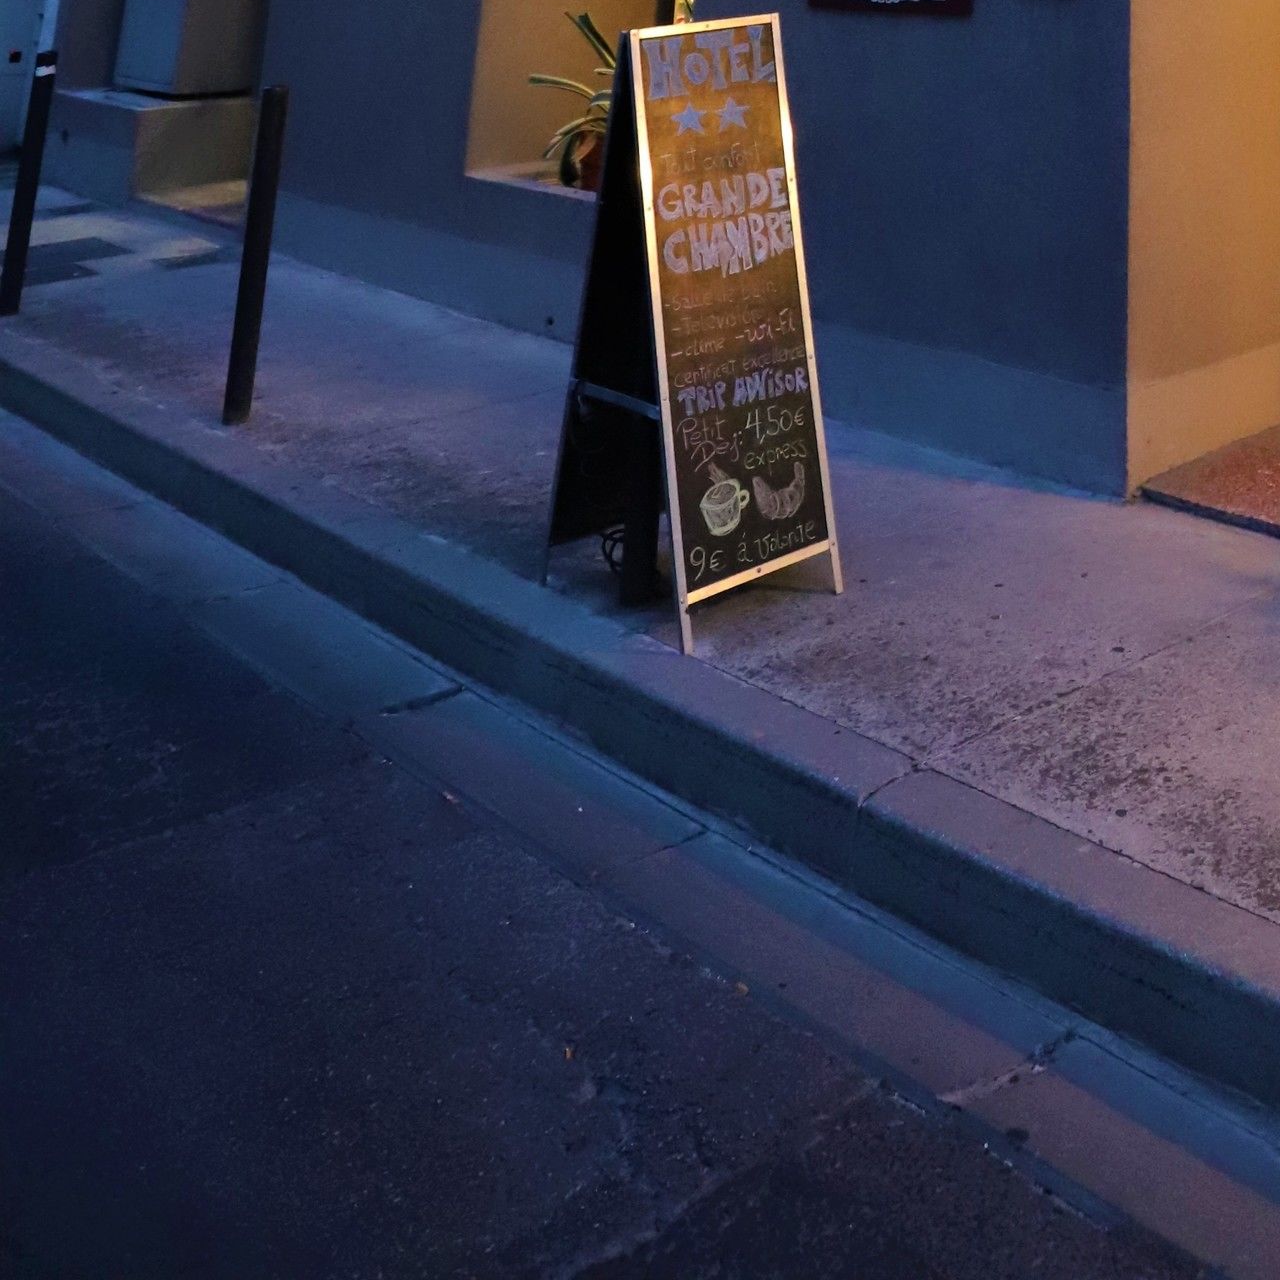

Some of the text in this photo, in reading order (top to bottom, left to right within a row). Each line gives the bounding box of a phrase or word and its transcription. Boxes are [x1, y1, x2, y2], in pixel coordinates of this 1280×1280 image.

[641, 24, 776, 100] HOTEL
[657, 167, 788, 221] GRANDE
[663, 210, 793, 278] CHAMBRE
